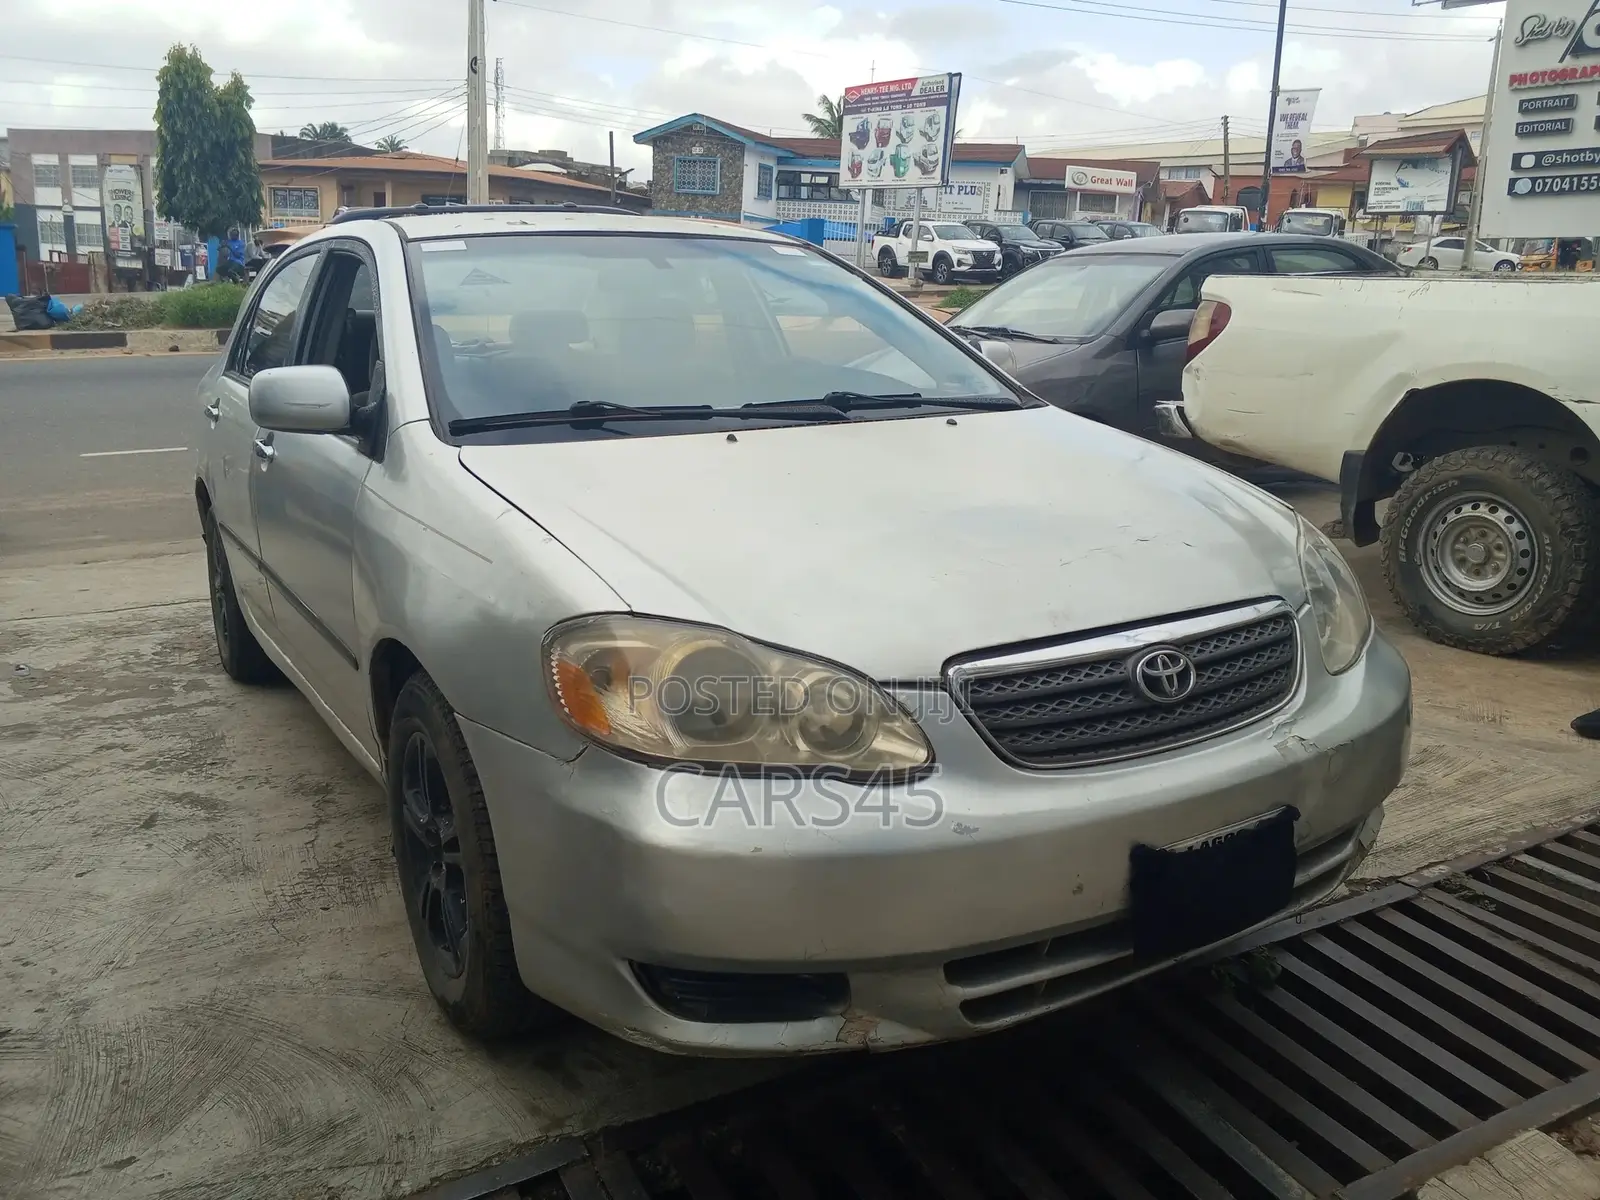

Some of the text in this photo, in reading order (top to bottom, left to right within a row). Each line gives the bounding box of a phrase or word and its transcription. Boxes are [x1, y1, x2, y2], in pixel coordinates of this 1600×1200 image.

[1509, 65, 1600, 88] PHOTOGRAP
[920, 85, 945, 94] DEALER
[1522, 98, 1570, 110] PORTRAIT
[1517, 121, 1567, 134] EDITORIAL
[1090, 175, 1133, 188] Great Wall
[1535, 176, 1600, 193] 0704155
[957, 184, 983, 196] PLUS
